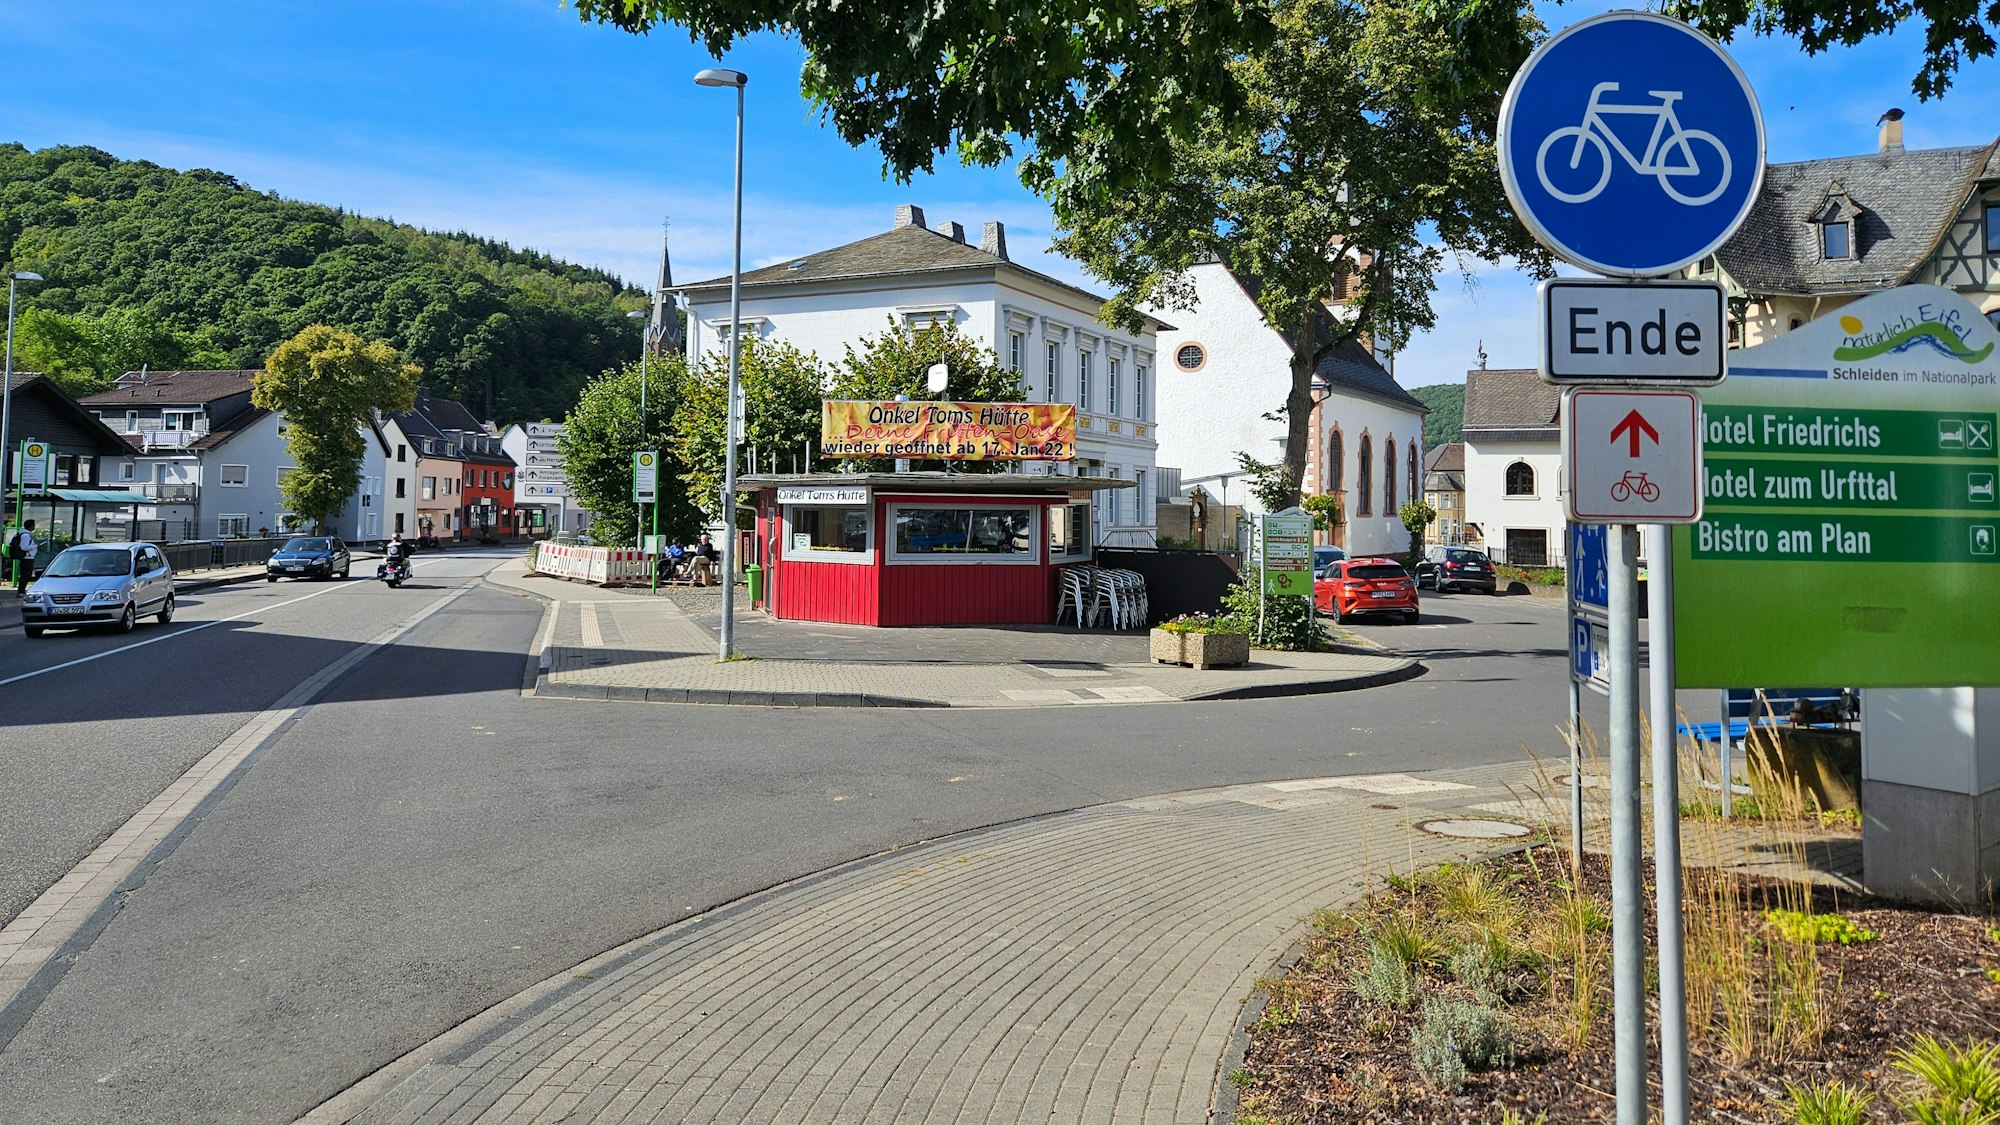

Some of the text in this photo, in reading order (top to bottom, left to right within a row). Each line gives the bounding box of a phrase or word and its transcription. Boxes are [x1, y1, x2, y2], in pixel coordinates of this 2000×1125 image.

[1569, 307, 1701, 356] Ende
[1843, 303, 1973, 349] natürlich Eifel
[1833, 367, 1997, 387] Schleiden im Nationalpark
[869, 406, 1029, 426] Onkel Toms Hütte
[922, 422, 1070, 441] Fritten-Oase
[1763, 414, 1881, 448] Friedrichs
[825, 441, 880, 455] wieder
[884, 441, 951, 456] geöffnet
[957, 441, 976, 455] ab
[982, 441, 1005, 456] 17.
[1011, 442, 1040, 456] Jan
[1044, 443, 1063, 457] 22
[779, 490, 806, 500] Onkel
[807, 490, 835, 500] Toms
[1764, 476, 1812, 500] zum
[1821, 469, 1898, 501] Urfttal
[1699, 521, 1872, 554] Bistro am Plan
[1577, 624, 1588, 668] P
